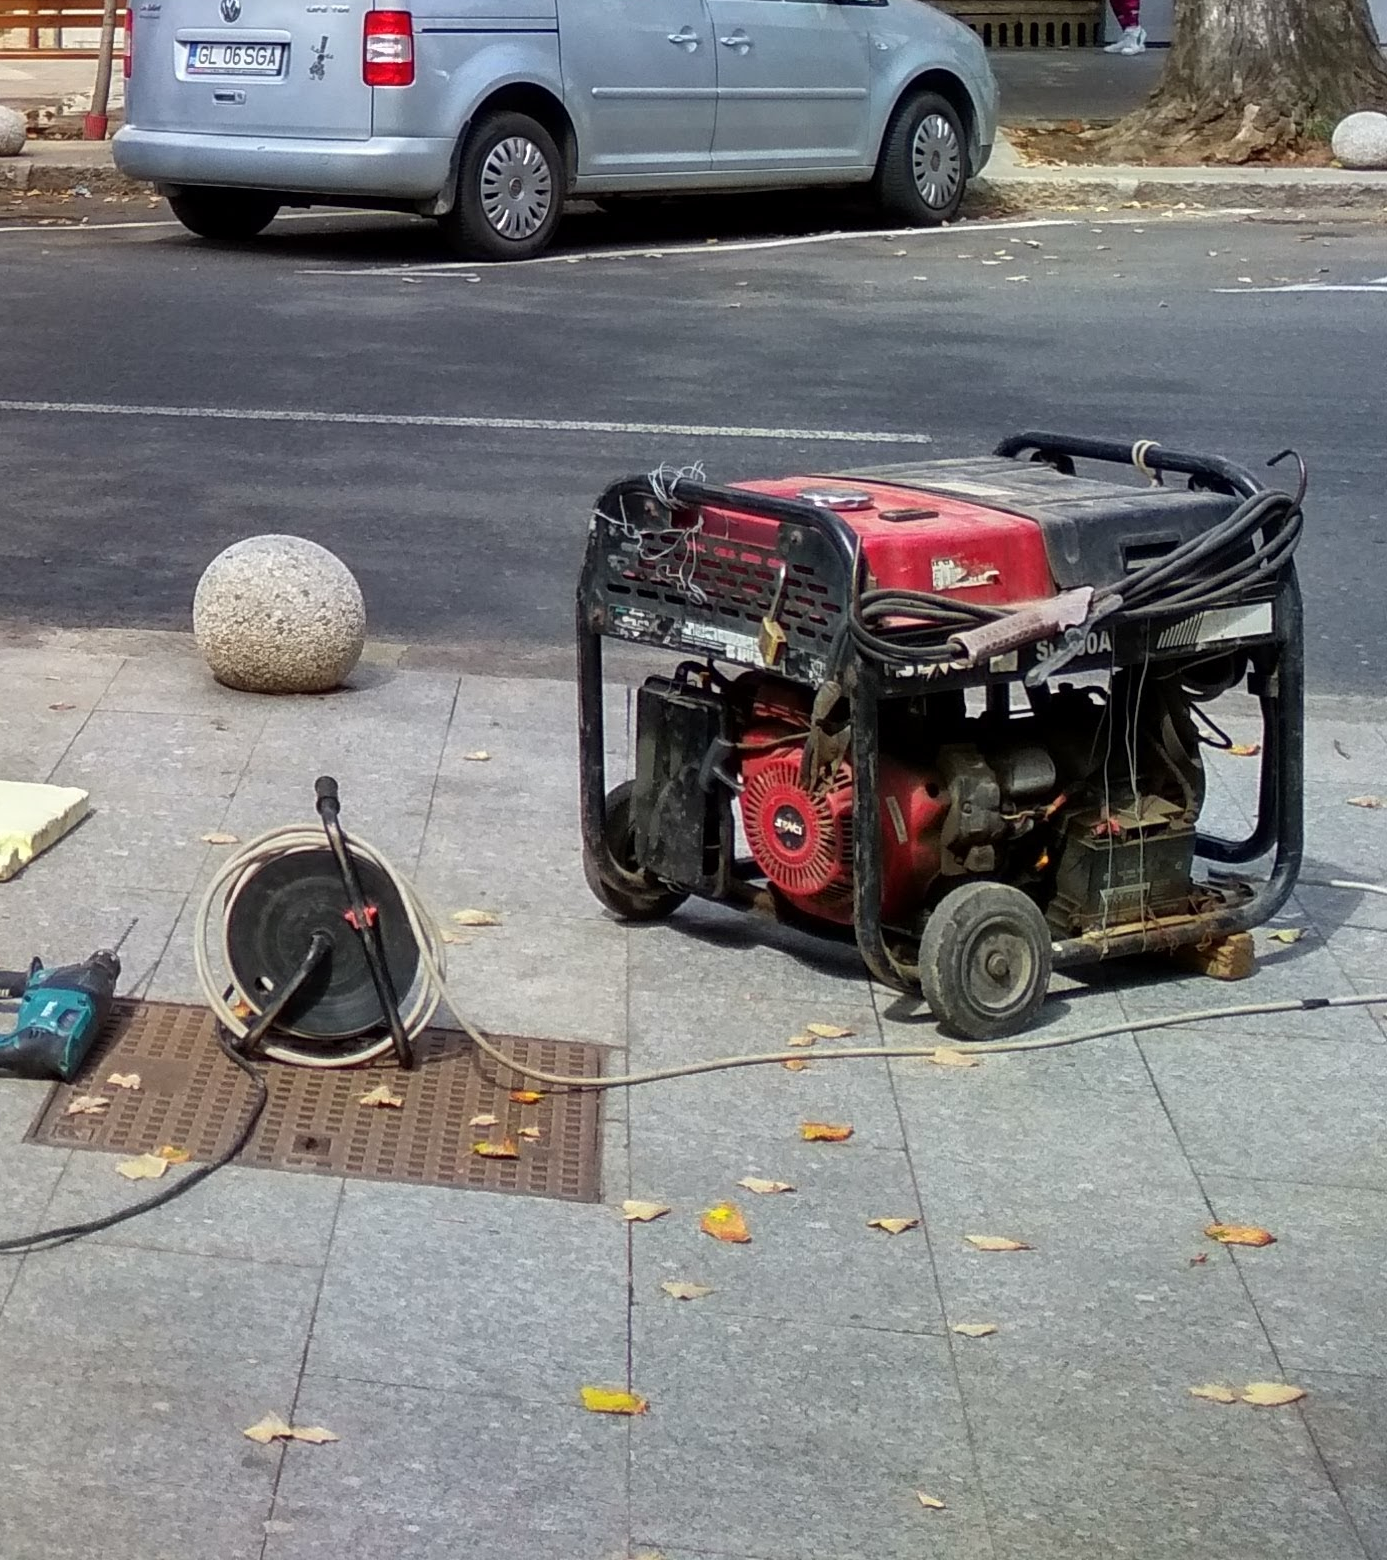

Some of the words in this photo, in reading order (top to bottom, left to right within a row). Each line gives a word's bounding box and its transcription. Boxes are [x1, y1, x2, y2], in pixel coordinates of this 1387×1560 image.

[198, 46, 217, 64] GL
[223, 46, 241, 65] 06
[243, 47, 277, 67] SGA
